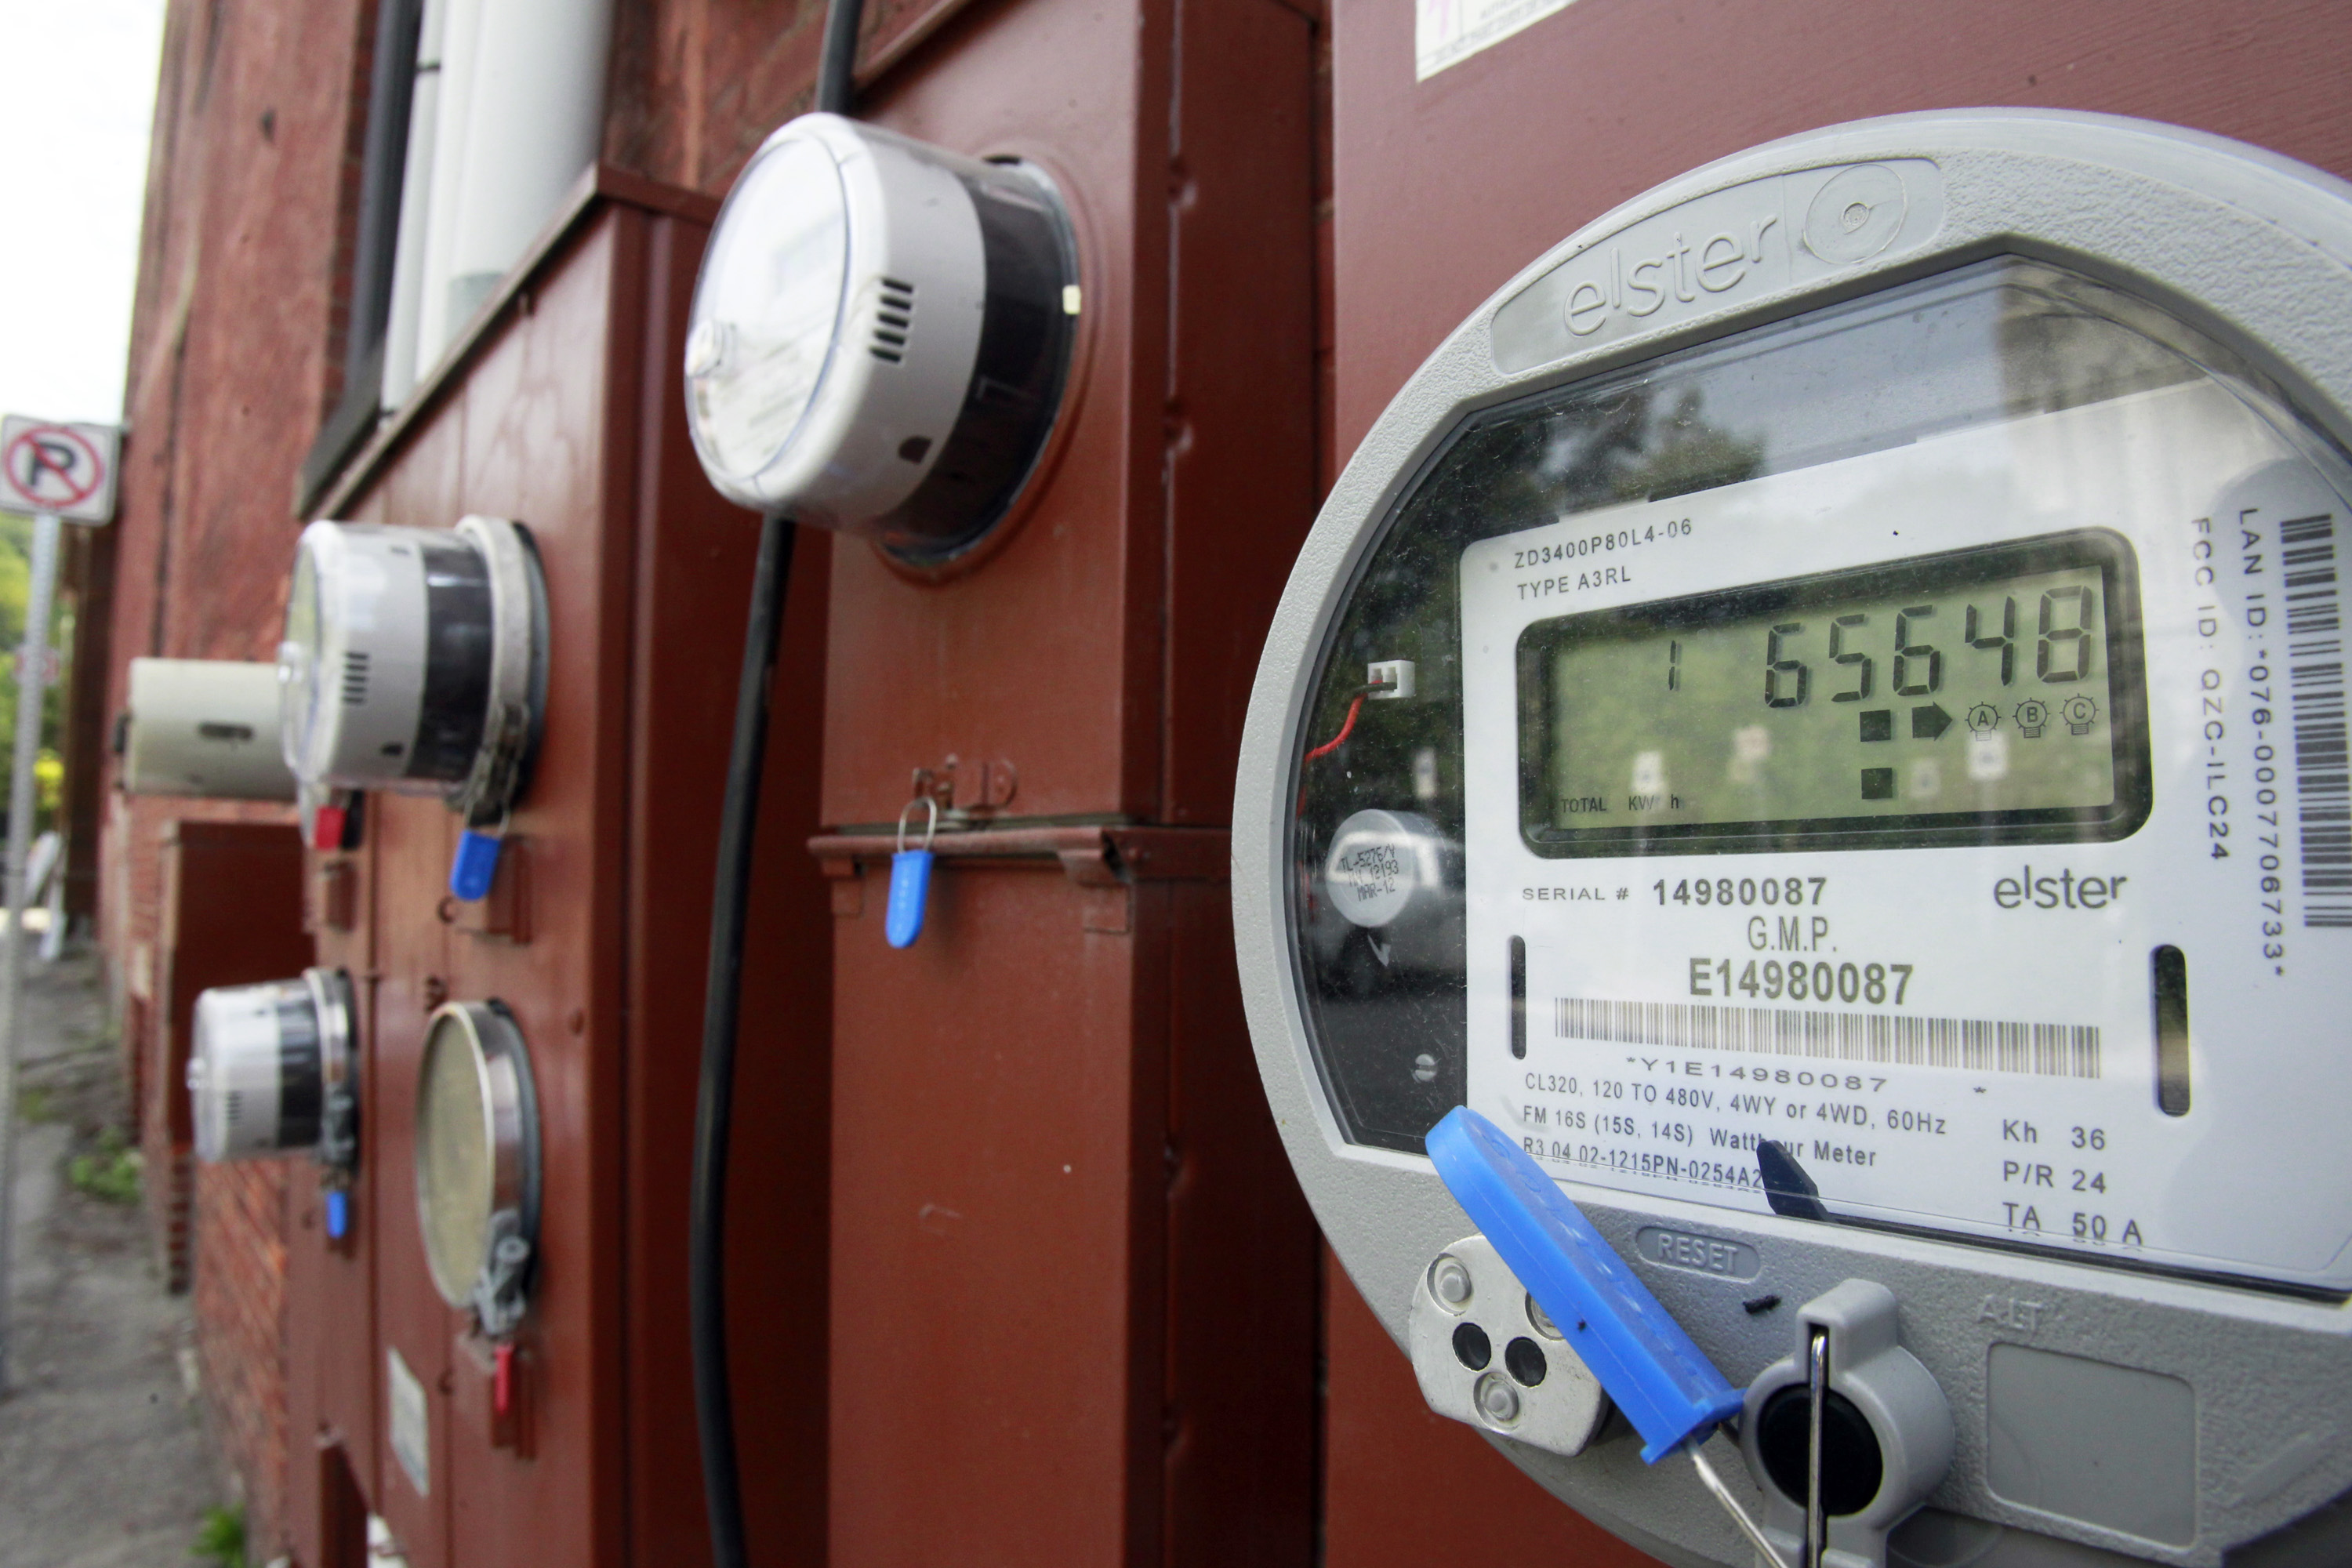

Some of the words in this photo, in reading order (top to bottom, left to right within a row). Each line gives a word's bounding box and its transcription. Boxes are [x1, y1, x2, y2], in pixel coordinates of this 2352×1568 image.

[1564, 214, 1778, 338] elster
[1514, 517, 1693, 569] ZD3400P80L4-06
[2191, 517, 2215, 586] FCC
[2239, 508, 2263, 575] LAN
[1516, 575, 1570, 600] TYPE
[1577, 565, 1632, 590] A3RL
[1764, 584, 2092, 709] 65648
[2201, 669, 2230, 860] QZC-ILC24
[1561, 797, 1607, 814] TOTAL
[1522, 887, 1606, 901] SERIAL
[1615, 887, 1630, 901] #
[1653, 876, 1828, 906] 14980087
[1993, 864, 2129, 909] elster
[1747, 915, 1838, 953] G.M.P.
[1689, 957, 1914, 1006] E14980087
[1525, 1073, 1584, 1098] CL320,
[1592, 1079, 1623, 1099] 120
[1631, 1083, 1657, 1103] TO
[1665, 1087, 1721, 1112] 480V,
[1730, 1093, 1777, 1116] 4WY
[1786, 1102, 1806, 1120] or
[1816, 1102, 1875, 1130] 4WD,
[1887, 1109, 1947, 1134] 60Hz
[1523, 1105, 1547, 1124] FM
[1555, 1109, 1586, 1129] 16S
[1594, 1113, 1642, 1139] (15S,
[1652, 1120, 1693, 1148] 14S)
[1709, 1127, 1804, 1157] Watthur
[1813, 1139, 1877, 1167] Meter
[2002, 1119, 2038, 1144] Kh
[2071, 1126, 2106, 1151] 36
[2003, 1160, 2054, 1188] P/R
[2071, 1169, 2107, 1194] 24
[2002, 1201, 2041, 1232] TA
[2071, 1212, 2107, 1240] 50
[2122, 1218, 2143, 1246] A
[1657, 1232, 1739, 1275] RESET
[1976, 1294, 2045, 1331] ALT
